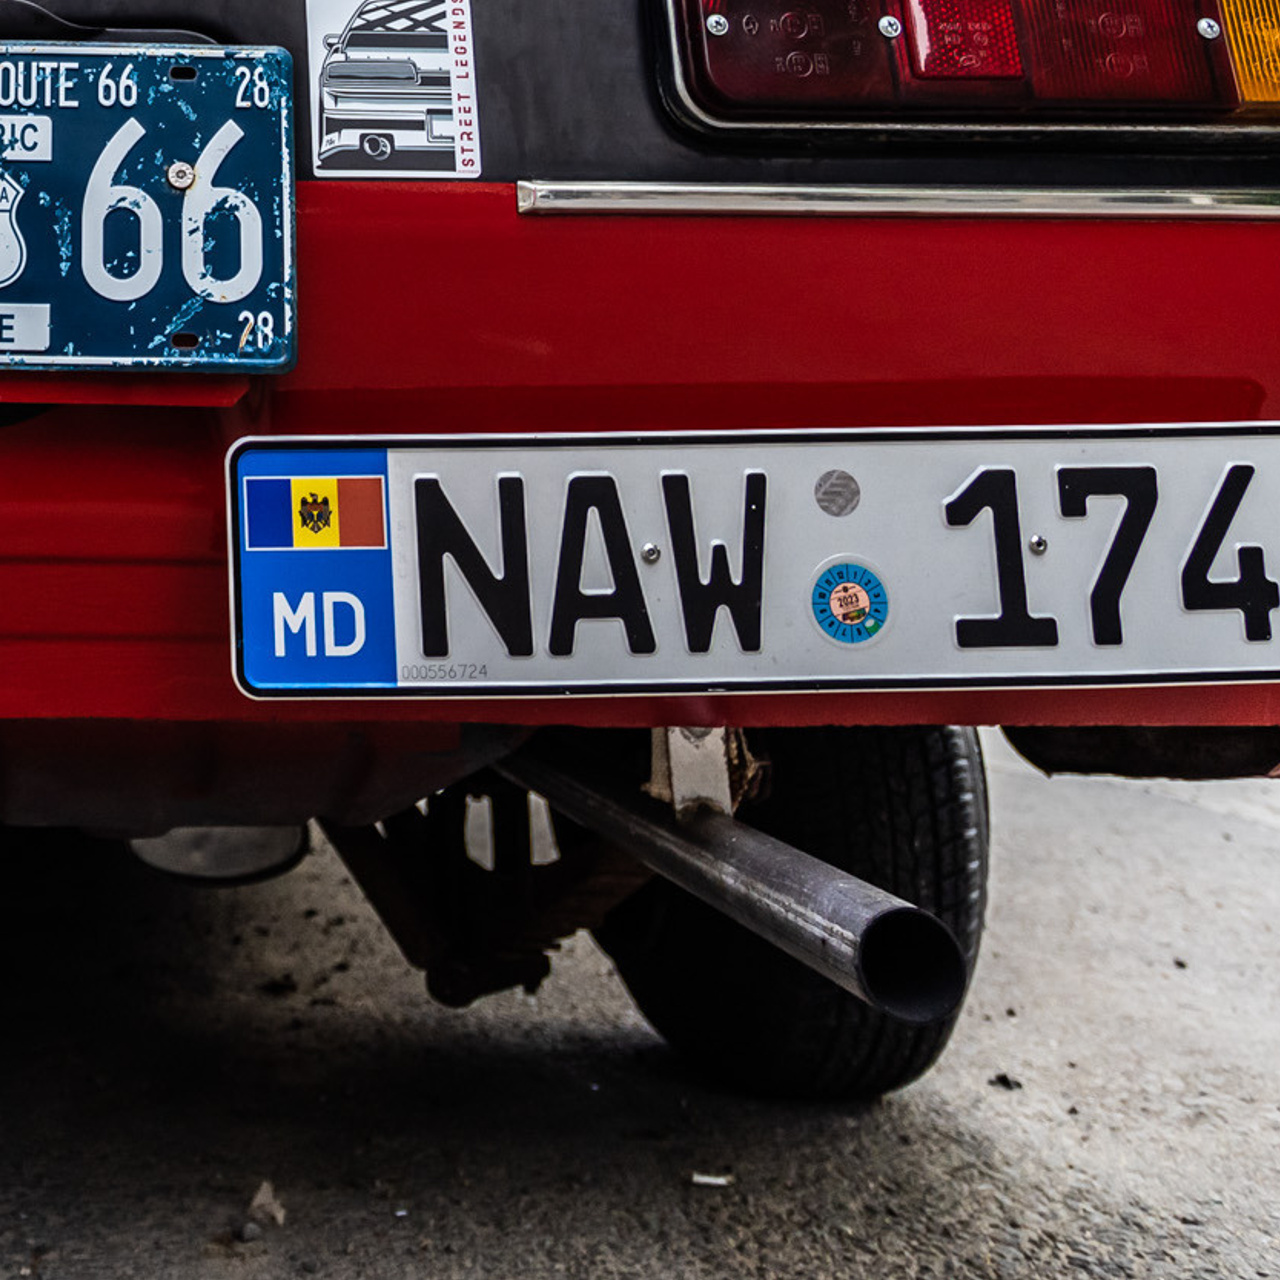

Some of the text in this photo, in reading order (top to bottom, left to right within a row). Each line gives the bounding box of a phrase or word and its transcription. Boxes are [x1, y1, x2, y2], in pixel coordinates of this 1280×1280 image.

[97, 63, 138, 108] 66
[234, 65, 270, 109] 28
[457, 92, 475, 168] STREET
[80, 117, 264, 303] 66
[411, 461, 1280, 660] NAW 174
[271, 589, 368, 659] MD
[401, 663, 488, 680] 000556724
